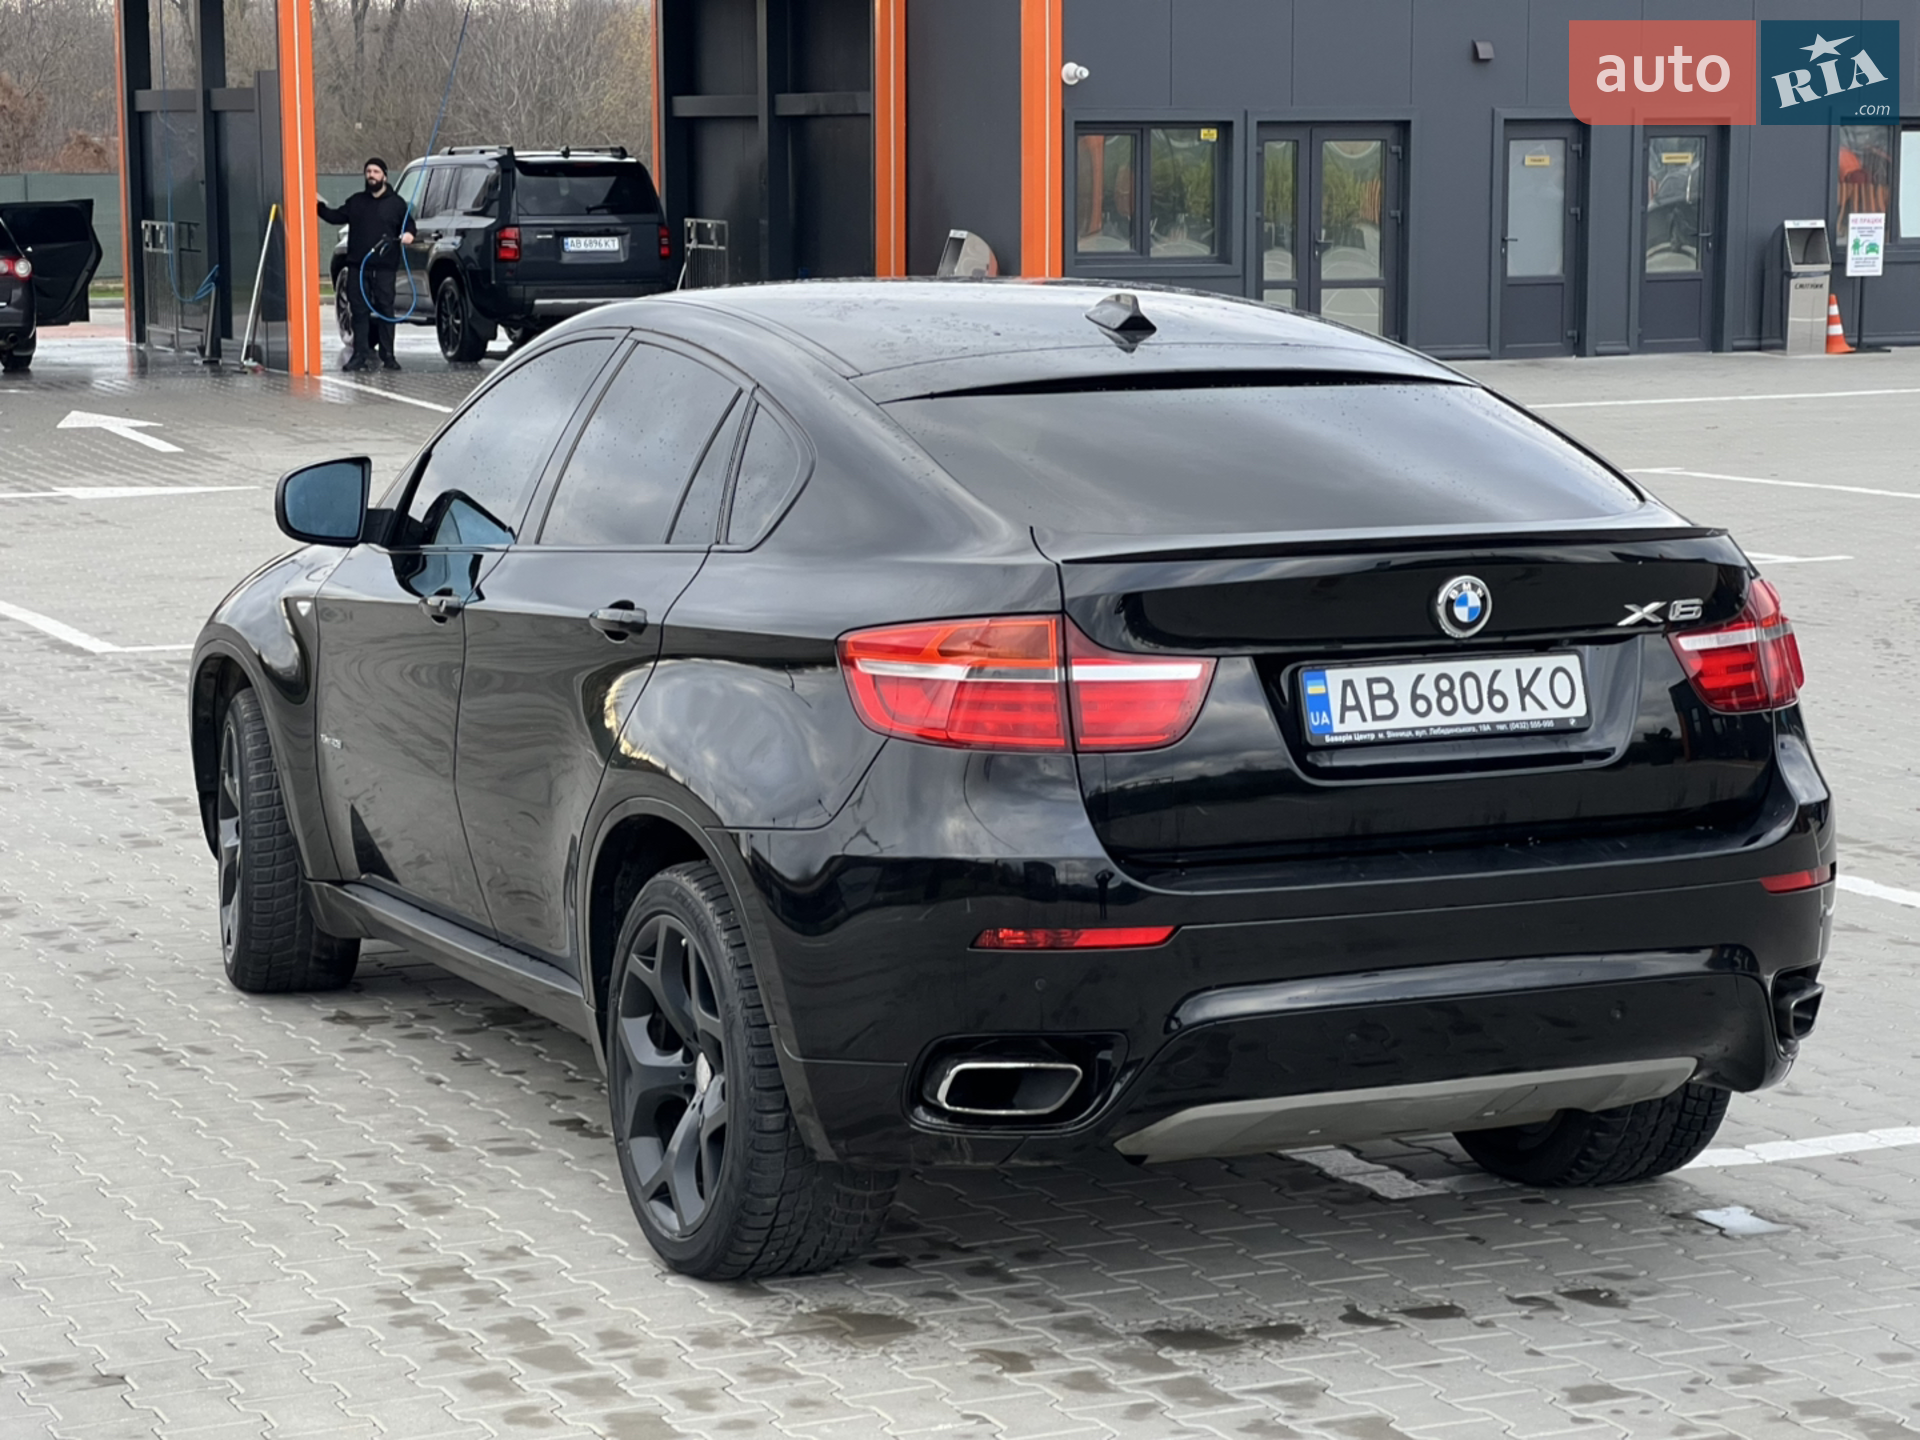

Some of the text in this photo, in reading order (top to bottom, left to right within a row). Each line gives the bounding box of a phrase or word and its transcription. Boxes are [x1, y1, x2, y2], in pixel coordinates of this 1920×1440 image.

[1617, 598, 1704, 626] X6
[1338, 666, 1577, 725] AB 6806 KO
[1310, 710, 1331, 726] UA
